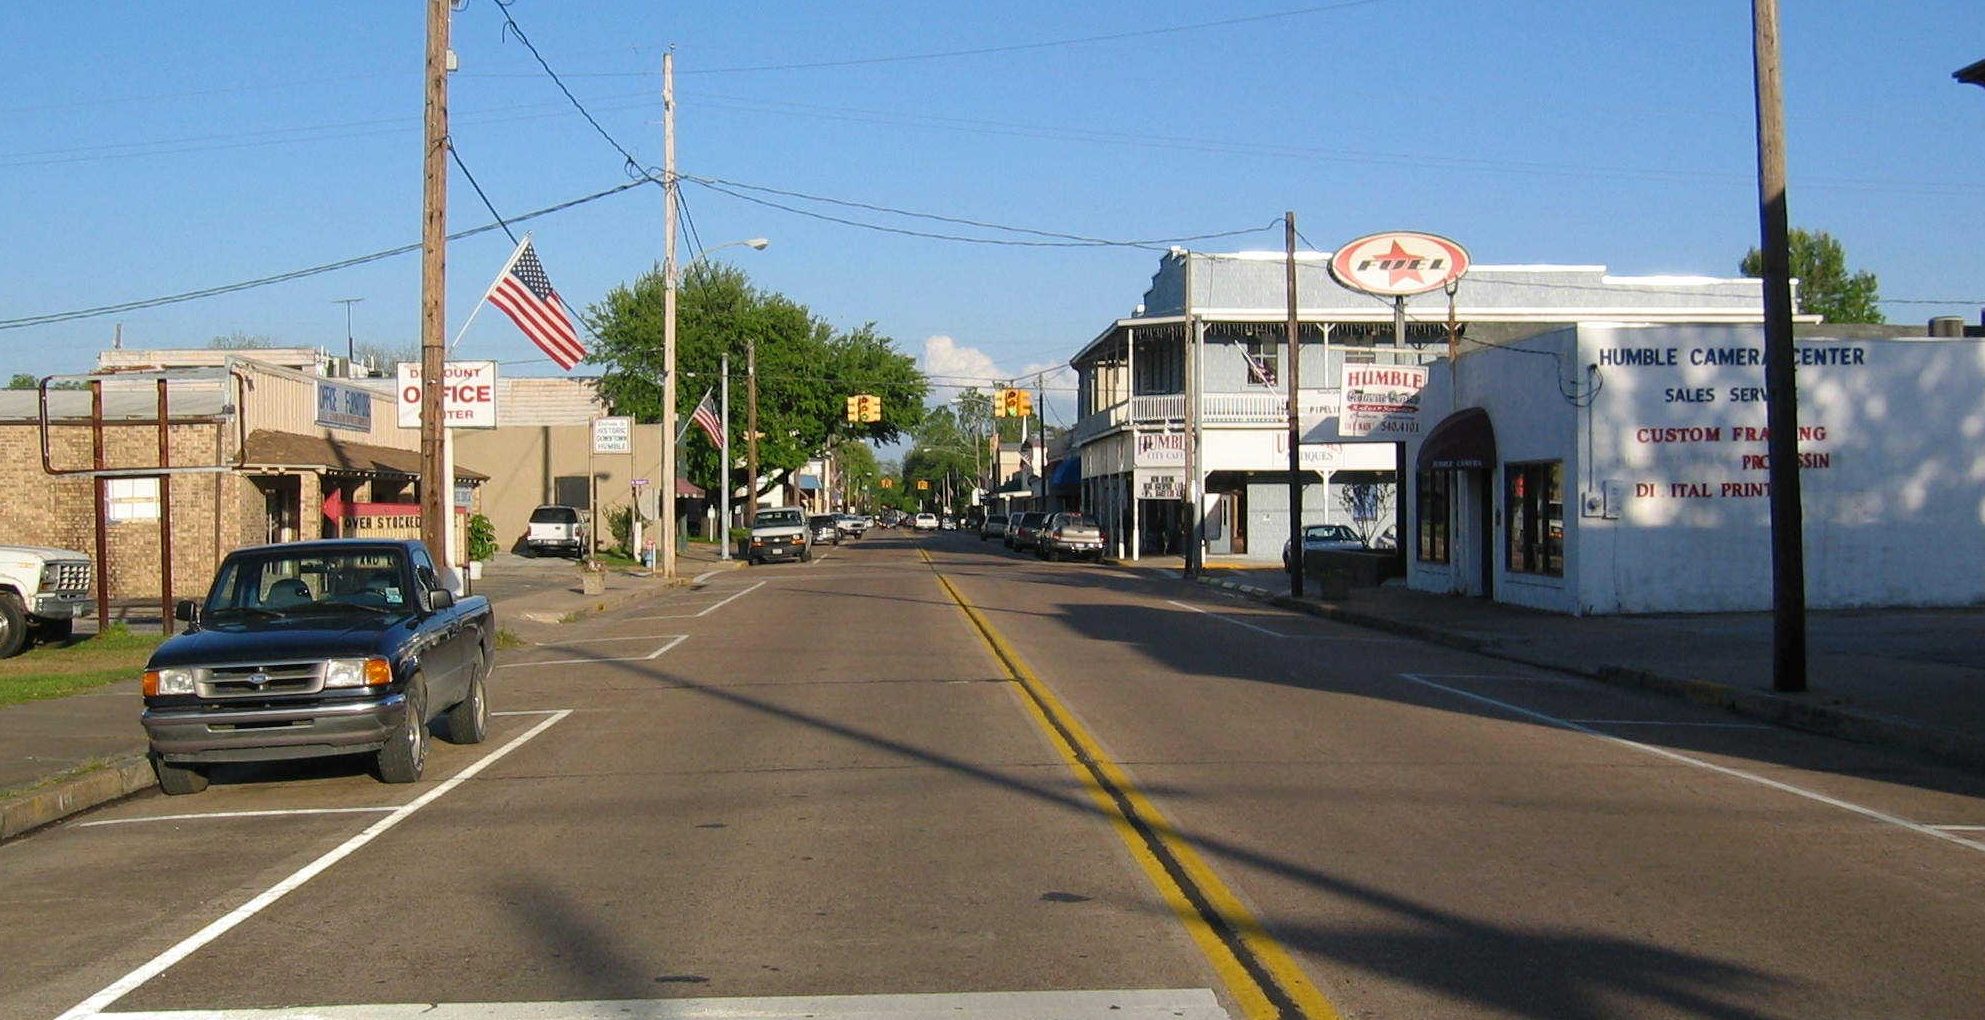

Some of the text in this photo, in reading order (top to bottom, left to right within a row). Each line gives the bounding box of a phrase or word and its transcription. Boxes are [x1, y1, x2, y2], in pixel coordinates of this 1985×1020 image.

[1357, 257, 1446, 272] FUEL
[1600, 348, 1678, 366] HUMBLE
[410, 367, 481, 379] DOUNT
[1348, 370, 1423, 390] HUMBLE
[1665, 387, 1798, 403] SALES SERV
[1637, 426, 1827, 444] CUSTOM FRANG
[1720, 482, 1771, 498] PRINT
[344, 516, 372, 529] OVER
